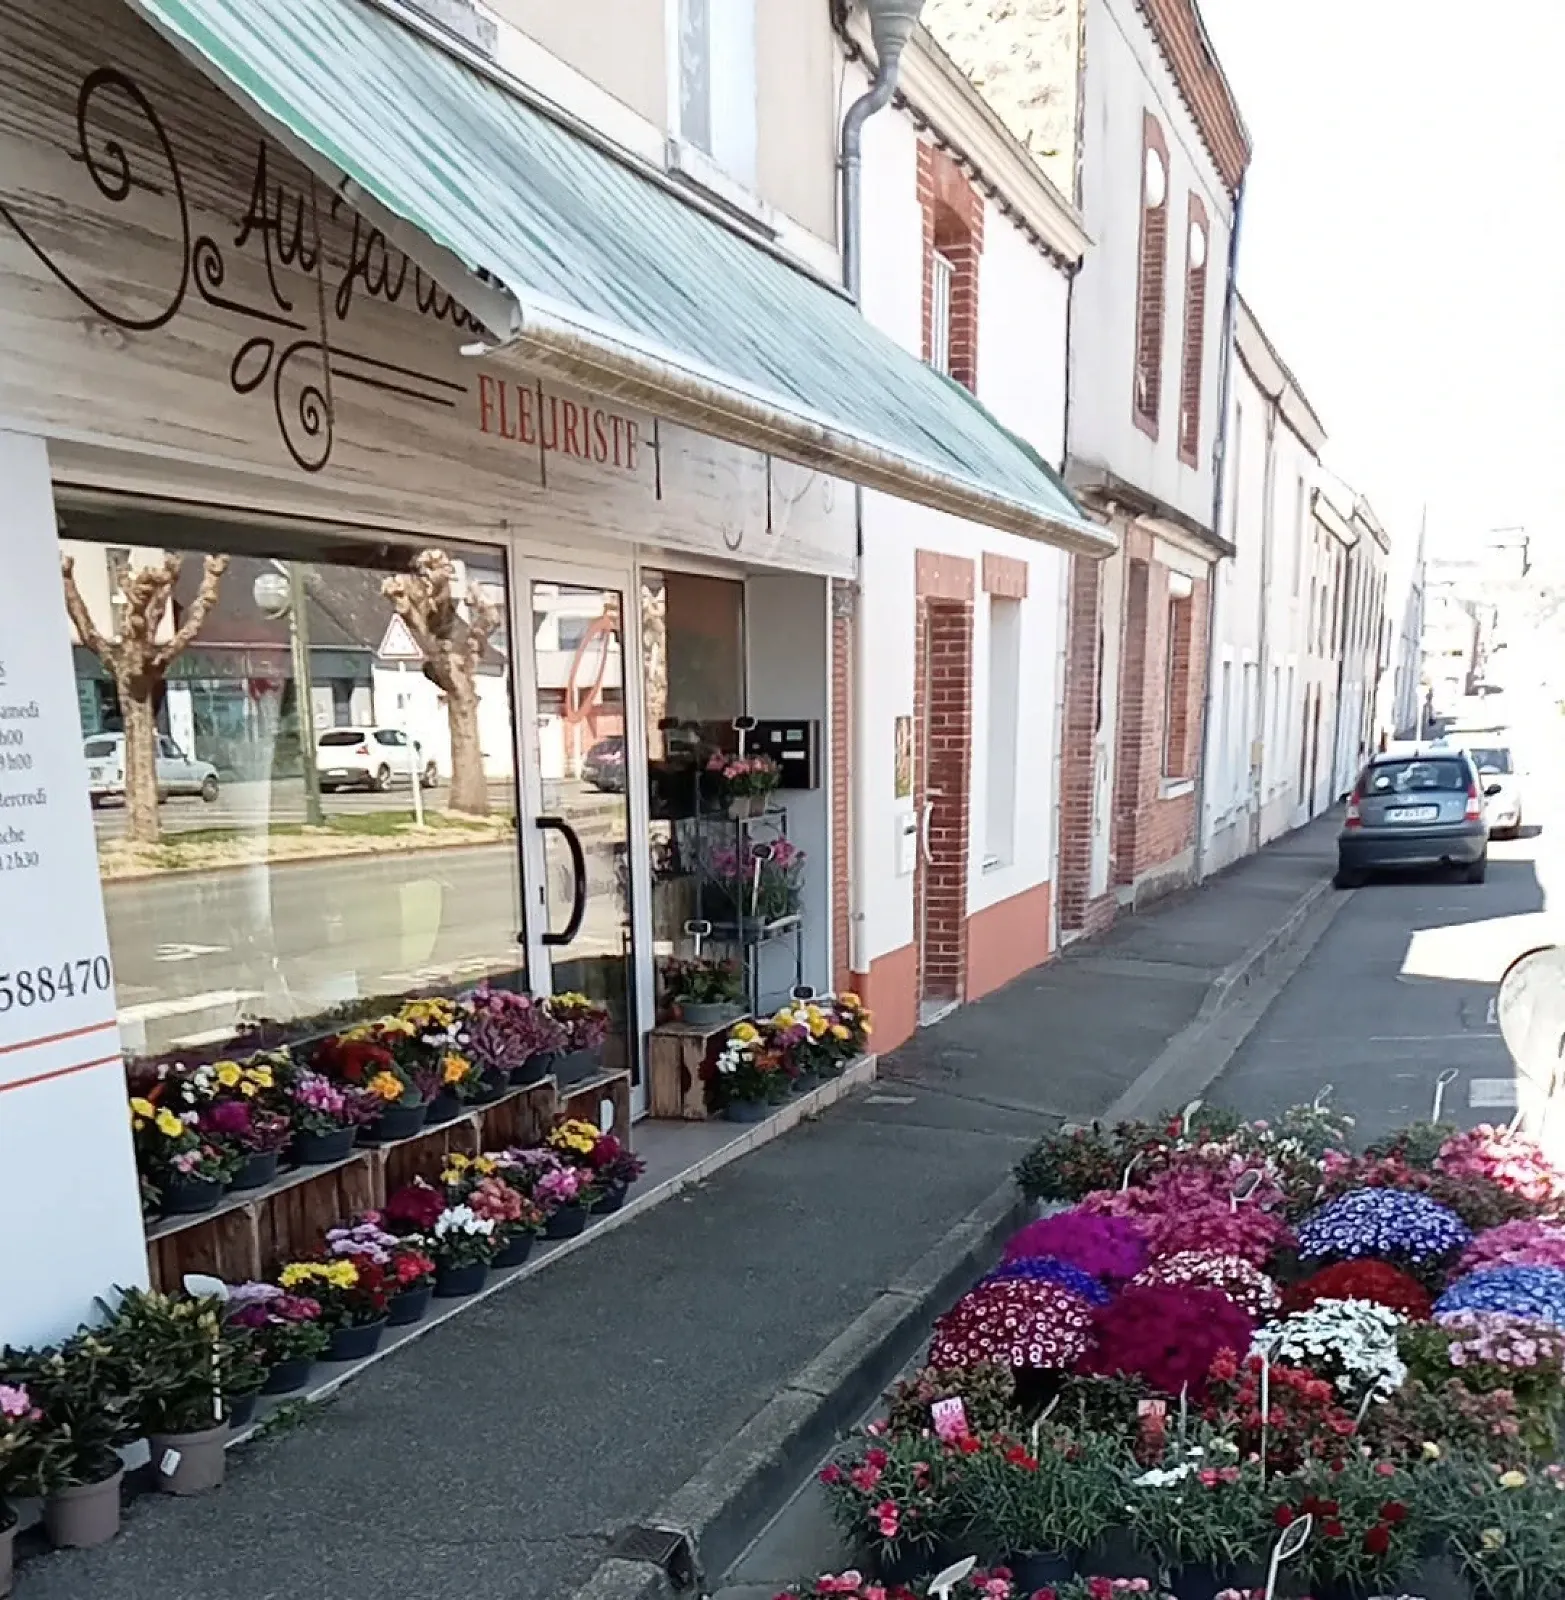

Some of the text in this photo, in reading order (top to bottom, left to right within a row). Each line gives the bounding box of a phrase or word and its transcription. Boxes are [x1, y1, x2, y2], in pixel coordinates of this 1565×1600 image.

[234, 138, 318, 312] Au
[477, 373, 641, 470] FLEURISTE
[0, 787, 47, 807] ercredi
[0, 955, 111, 1012] 588470
